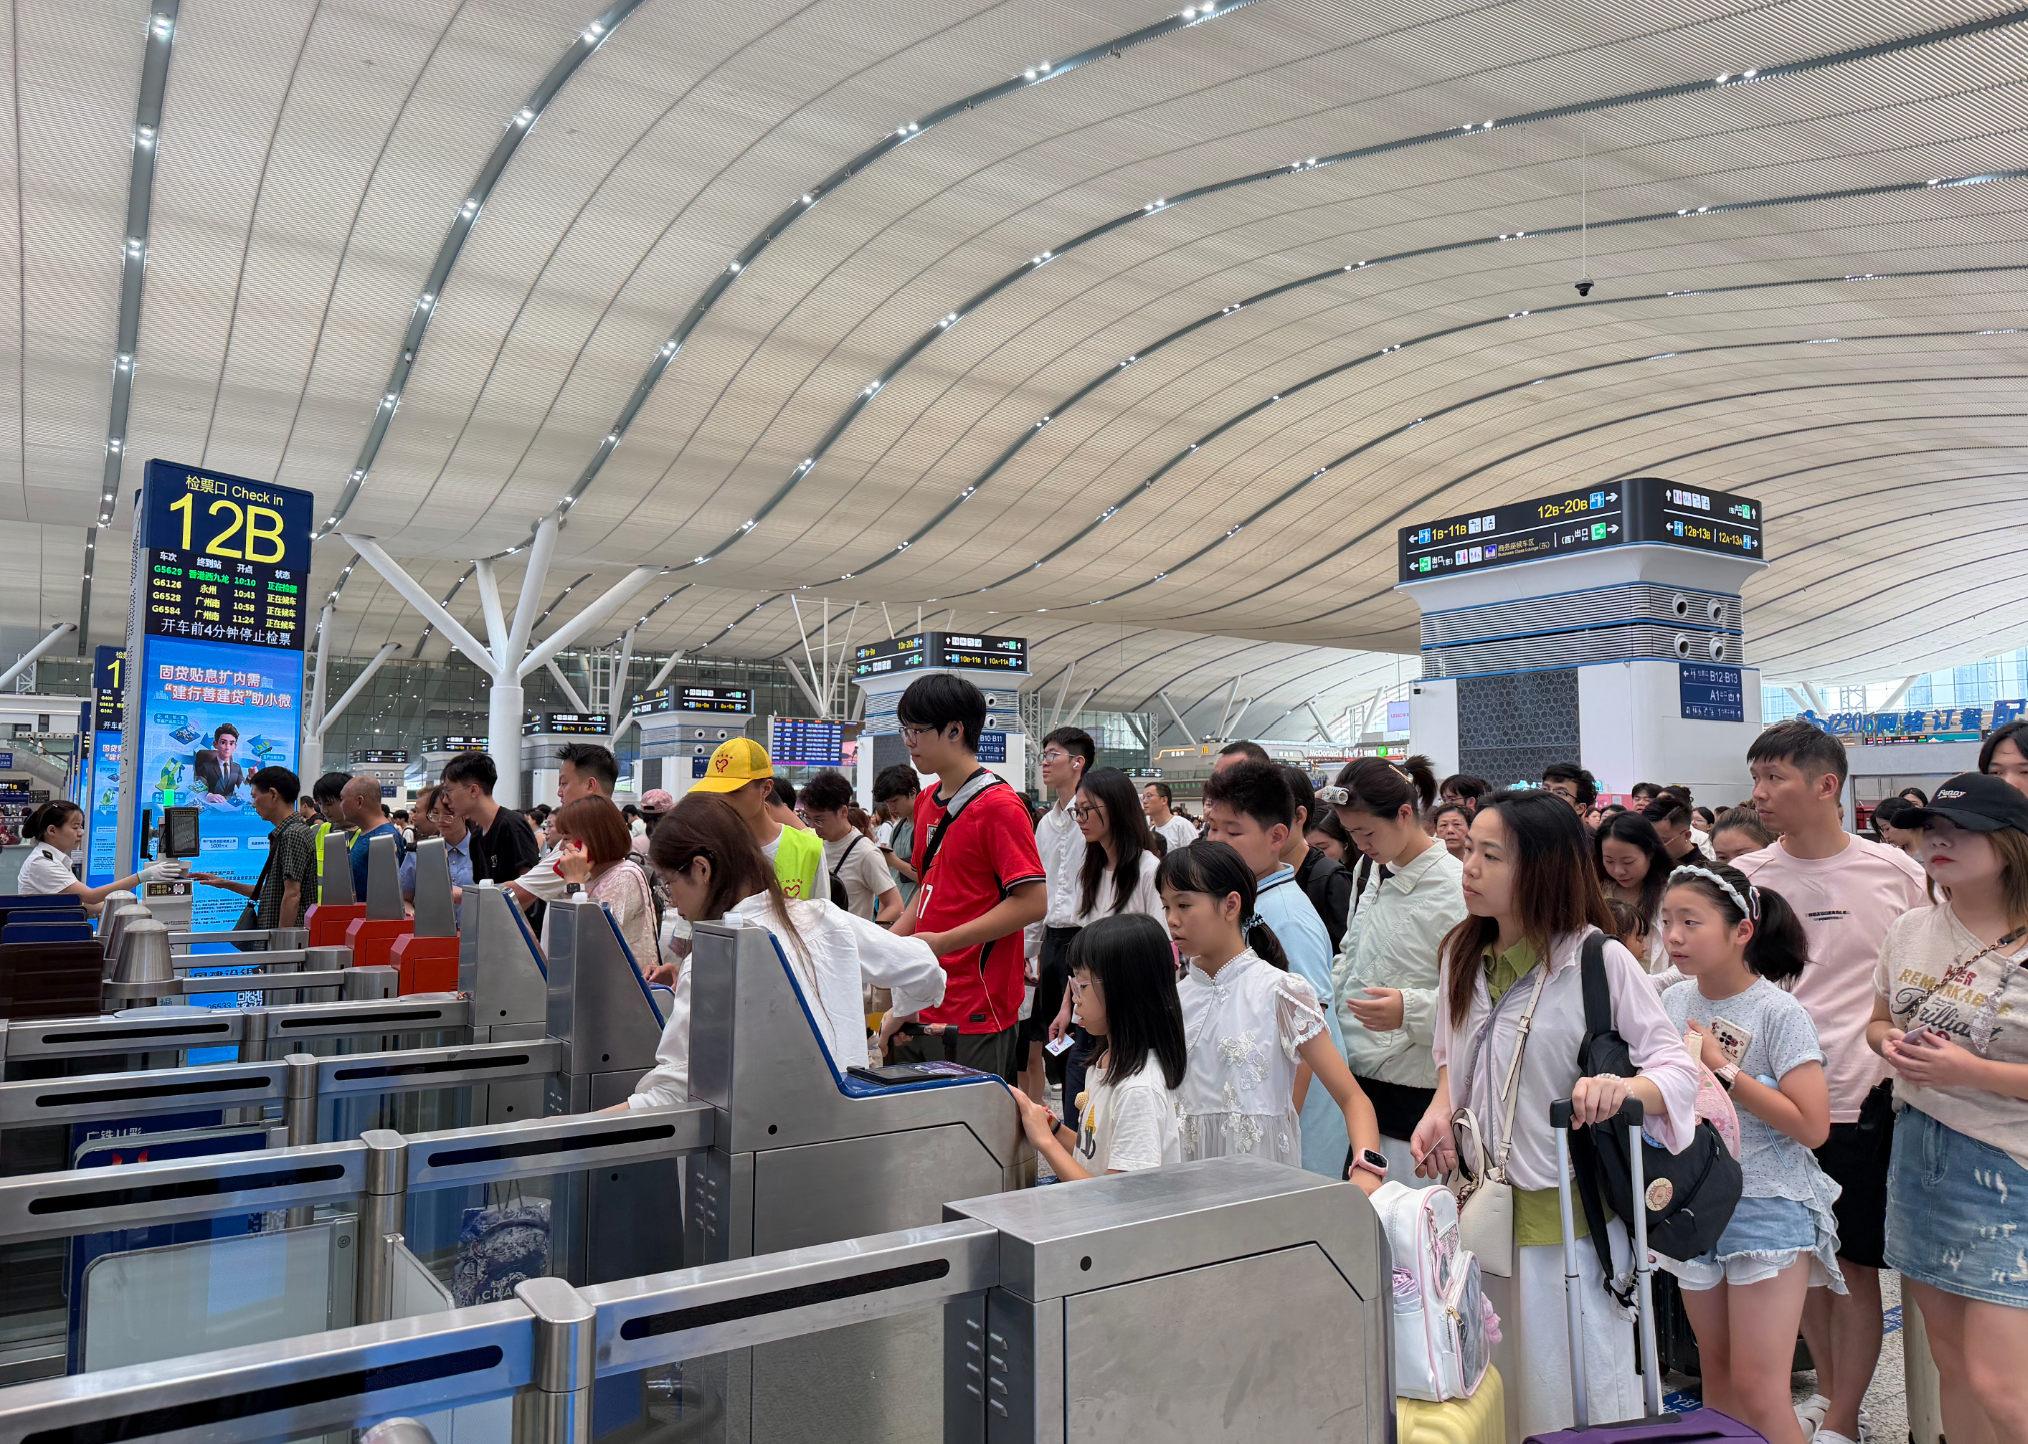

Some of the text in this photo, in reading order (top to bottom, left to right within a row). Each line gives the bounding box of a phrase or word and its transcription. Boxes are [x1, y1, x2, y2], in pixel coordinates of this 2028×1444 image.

[186, 475, 284, 507] 检票口 Check in
[1538, 499, 1588, 519] 12B-20B
[170, 492, 286, 564] 12B
[1431, 524, 1467, 541] 1B-11B
[1574, 528, 1588, 538] 出口
[1684, 525, 1743, 546] 12B-13B 12A-13A
[160, 551, 291, 580] 车次 终到站 开点 状态
[153, 578, 297, 606] G6126 永州 10:43 正在候车
[154, 565, 298, 594] G5629 香港西九龙 10:10 正在检票
[152, 591, 296, 618] G6528 广州南 10:58 正在候车
[152, 605, 295, 630] G6584 广州南 11:24 正在候车
[161, 618, 291, 646] 开车前4分钟停止检票
[159, 664, 261, 688] 固贷贴息扩内需
[1710, 670, 1738, 684] B12-B13
[1710, 689, 1720, 701] A1
[1309, 748, 1343, 757] McDonald's
[916, 883, 934, 919] 17
